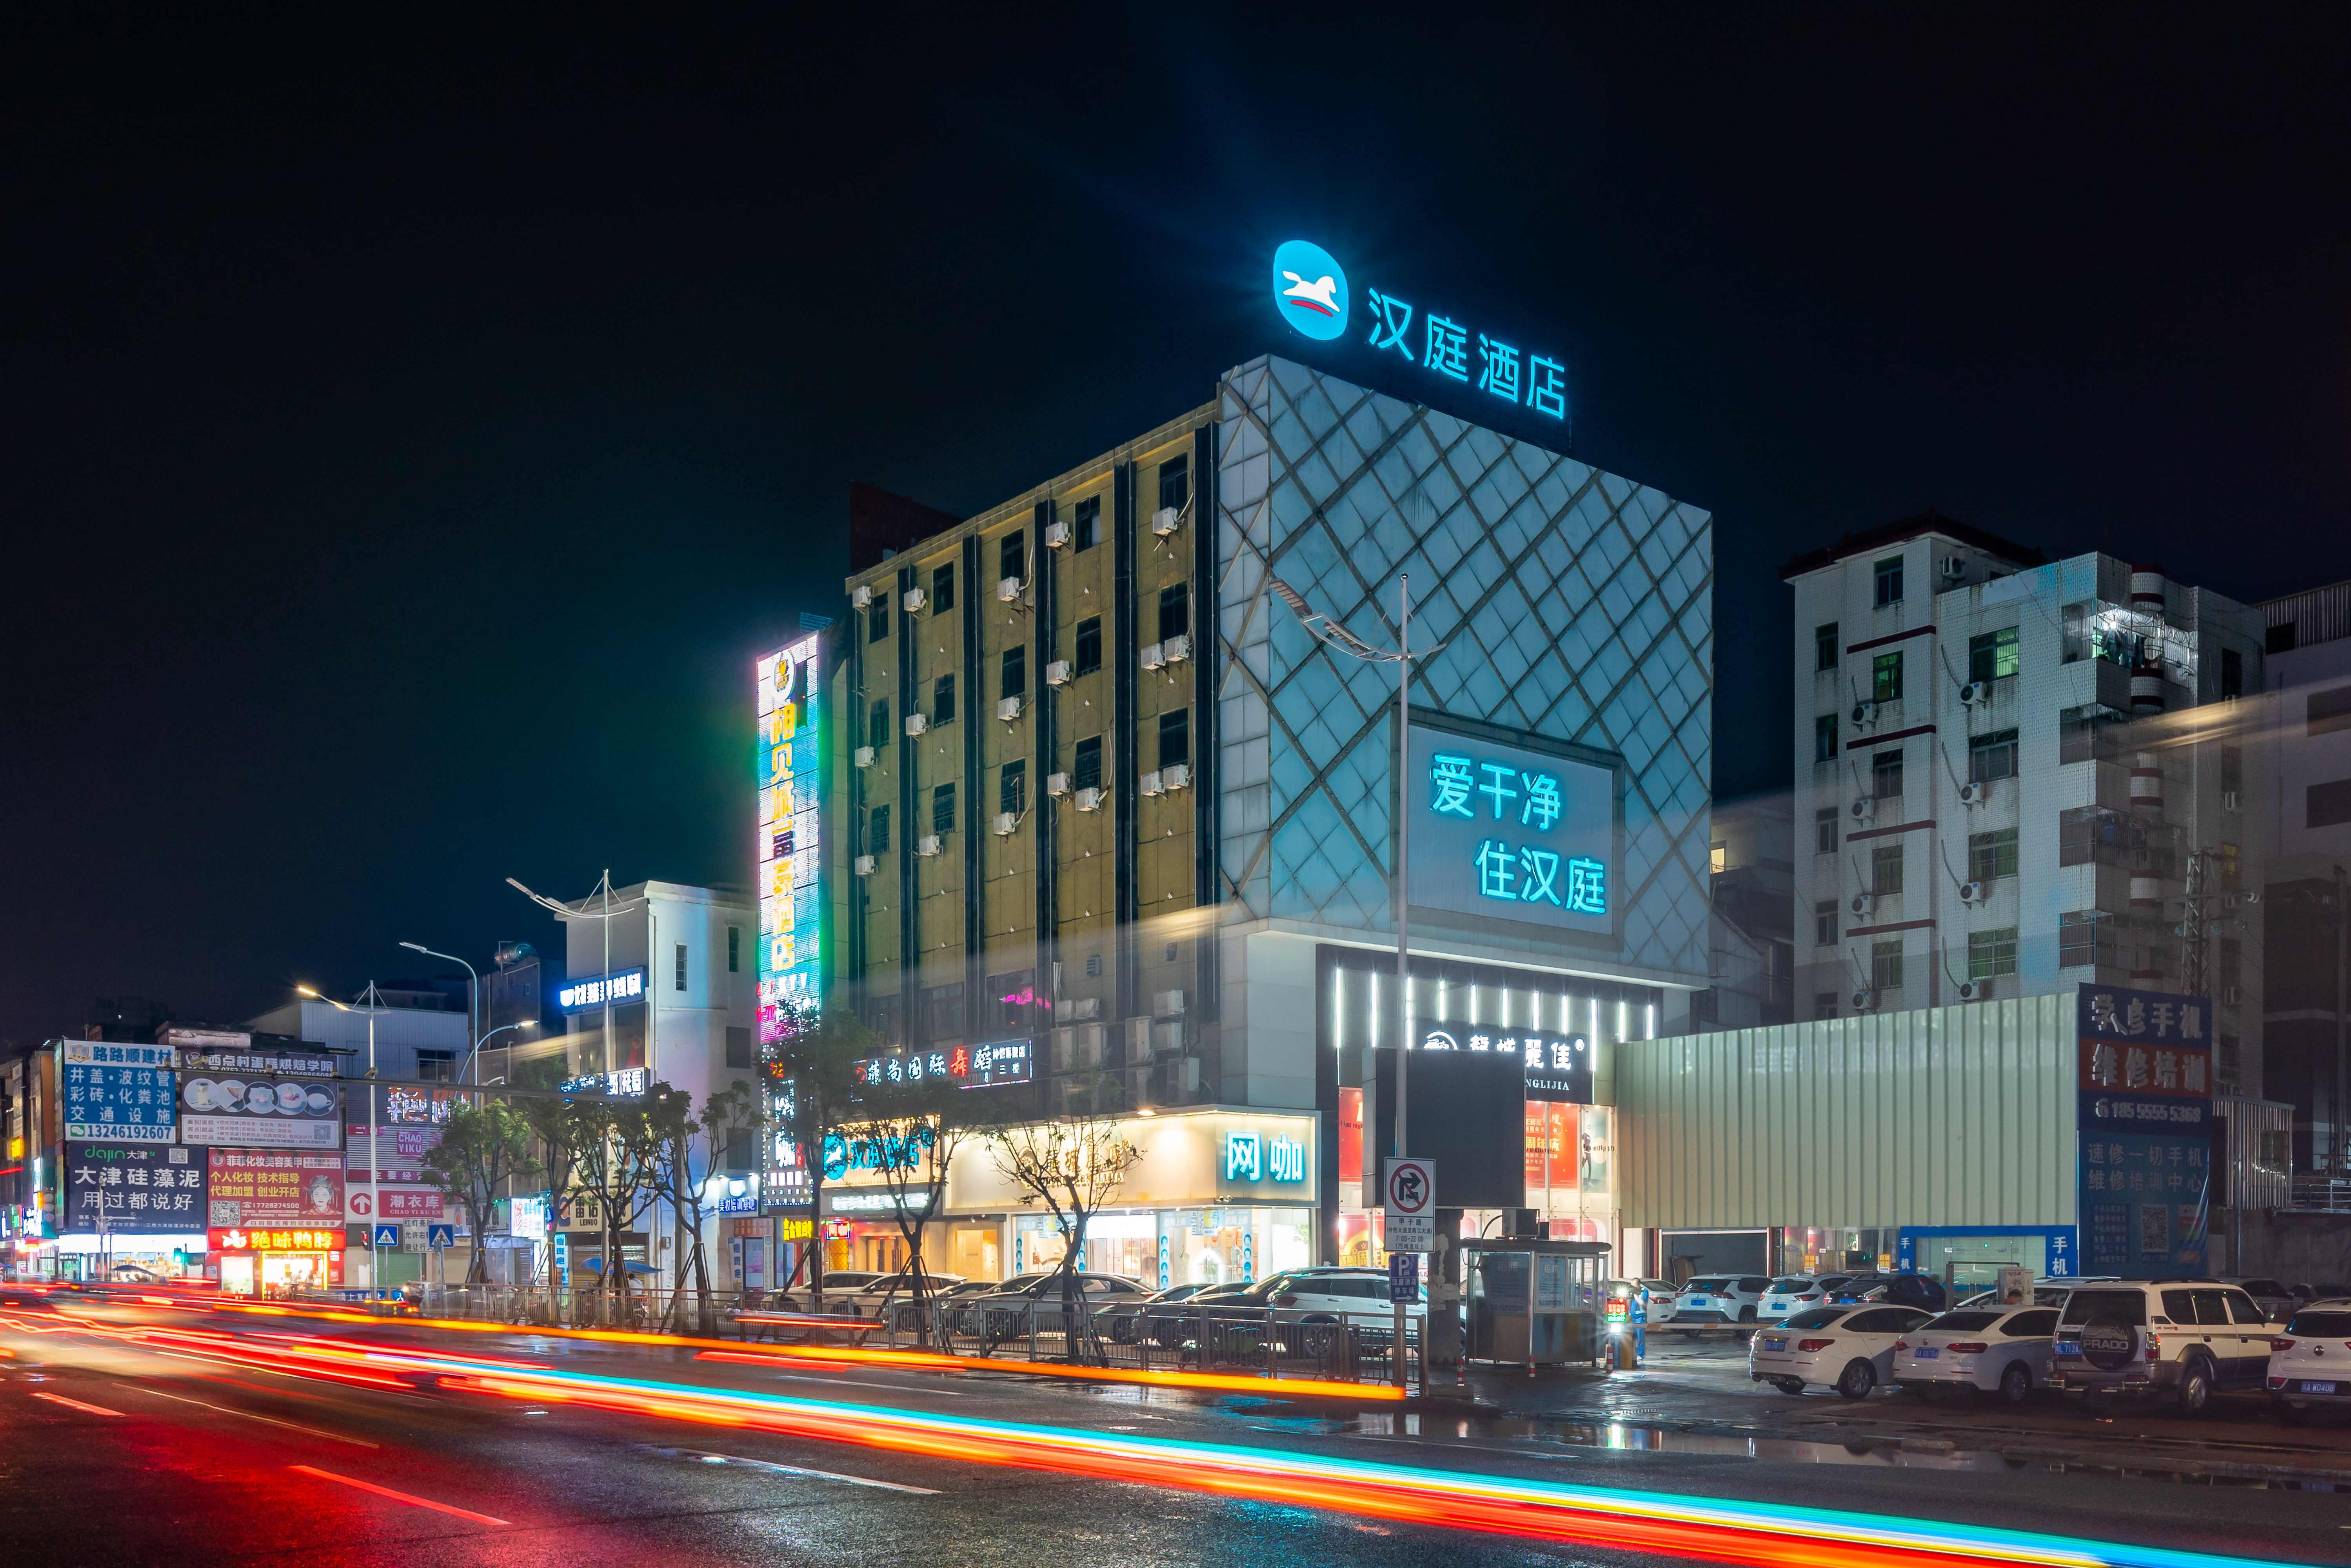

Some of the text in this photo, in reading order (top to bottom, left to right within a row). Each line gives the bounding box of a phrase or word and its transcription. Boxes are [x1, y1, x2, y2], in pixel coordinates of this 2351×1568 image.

[1368, 287, 1564, 419] 汉庭酒店
[1430, 754, 1560, 829] 爱干净
[1473, 839, 1606, 914] 住汉庭
[93, 1046, 172, 1065] 路路顺建材
[208, 1054, 333, 1072] 西点村蛋糕烘焙学院
[2092, 1044, 2206, 1093] 维修培训
[71, 1105, 171, 1124] 交通设施
[2137, 1103, 2168, 1120] 5555
[87, 1124, 171, 1139] 13246192607
[398, 1134, 422, 1143] CHAO
[84, 1145, 125, 1162] dajin
[127, 1150, 147, 1160] 大津
[398, 1143, 422, 1153] YIKU
[1226, 1131, 1304, 1181] 网咖
[2088, 1142, 2202, 1167] 速修一切手机
[227, 1155, 302, 1168] 菲菲化妆美容美甲
[75, 1166, 200, 1187] 大津硅藻泥
[210, 1171, 300, 1184] 个人化妆 技术指导
[2088, 1169, 2202, 1192] 维修培训中心
[82, 1191, 193, 1210] 用过都说好
[210, 1185, 300, 1198] 代理加盟 创业开店
[390, 1195, 439, 1209] 潮衣库
[1399, 1218, 1422, 1226] 甲子路
[251, 1230, 332, 1249] 绝味鸭脖
[1900, 1237, 1910, 1270] 手机
[2052, 1235, 2068, 1276] 手机
[1399, 1256, 1410, 1276] P
[1498, 1261, 1519, 1272] 招聘
[1544, 1264, 1559, 1274] 招聘
[1394, 1287, 1415, 1295] 停车场
[2082, 1339, 2129, 1350] PRADO
